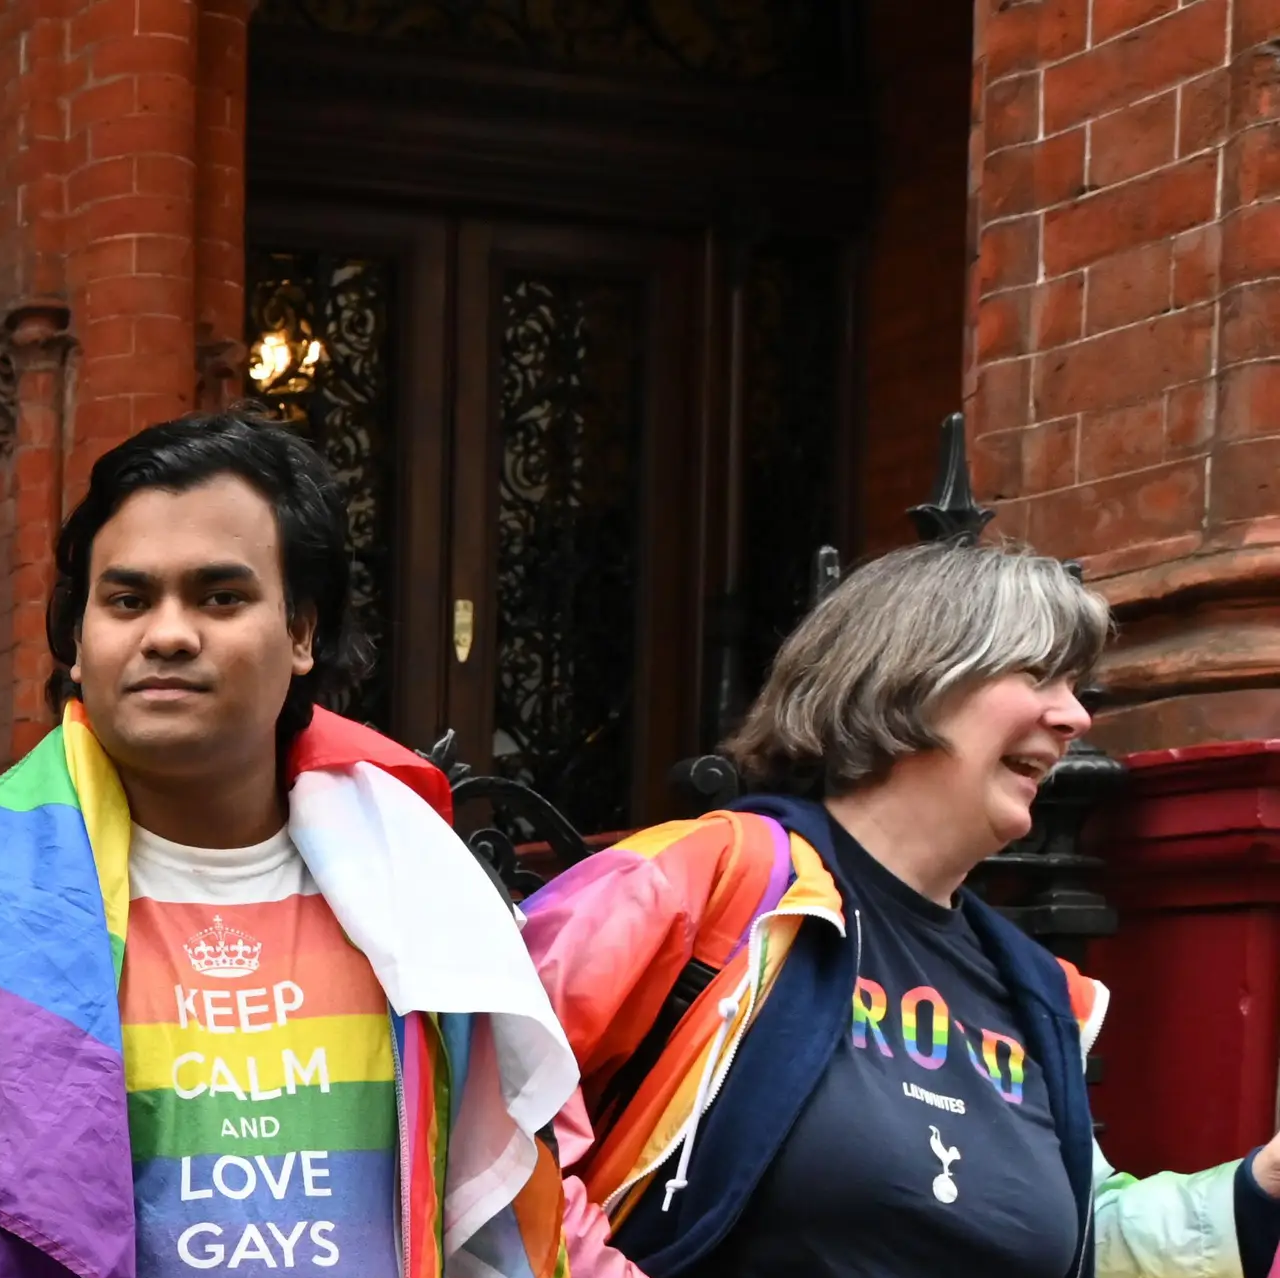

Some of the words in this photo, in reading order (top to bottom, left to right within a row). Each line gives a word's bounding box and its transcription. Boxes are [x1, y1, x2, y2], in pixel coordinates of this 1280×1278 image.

[174, 980, 305, 1034] KEEP
[170, 1047, 330, 1101] CALM
[220, 1116, 280, 1139] AND
[180, 1150, 333, 1201] LOVE
[176, 1220, 340, 1269] GAYS
